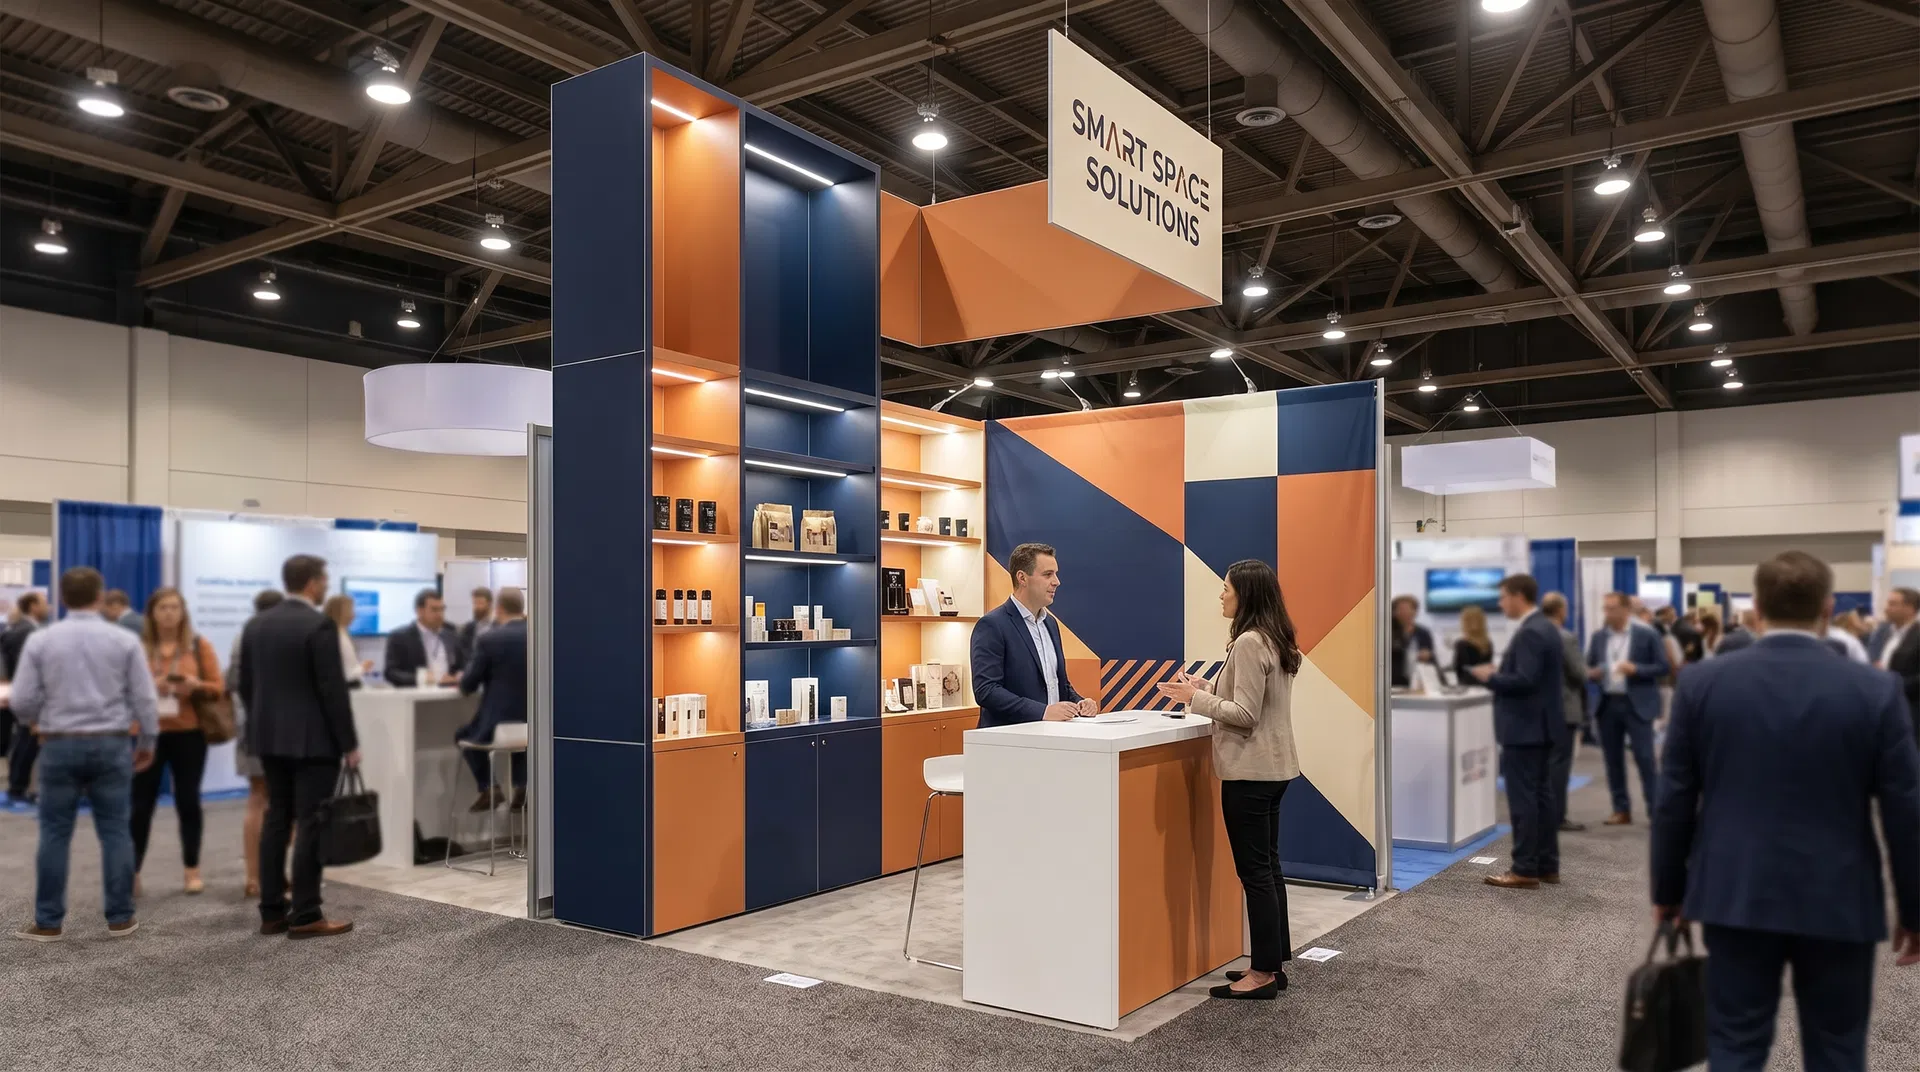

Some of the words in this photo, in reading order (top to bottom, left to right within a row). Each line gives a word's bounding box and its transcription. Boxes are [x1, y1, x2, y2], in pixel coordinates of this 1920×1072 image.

[1072, 98, 1148, 172] SMART
[1152, 150, 1210, 212] SPACE
[1086, 156, 1200, 246] SOLUTIONS
